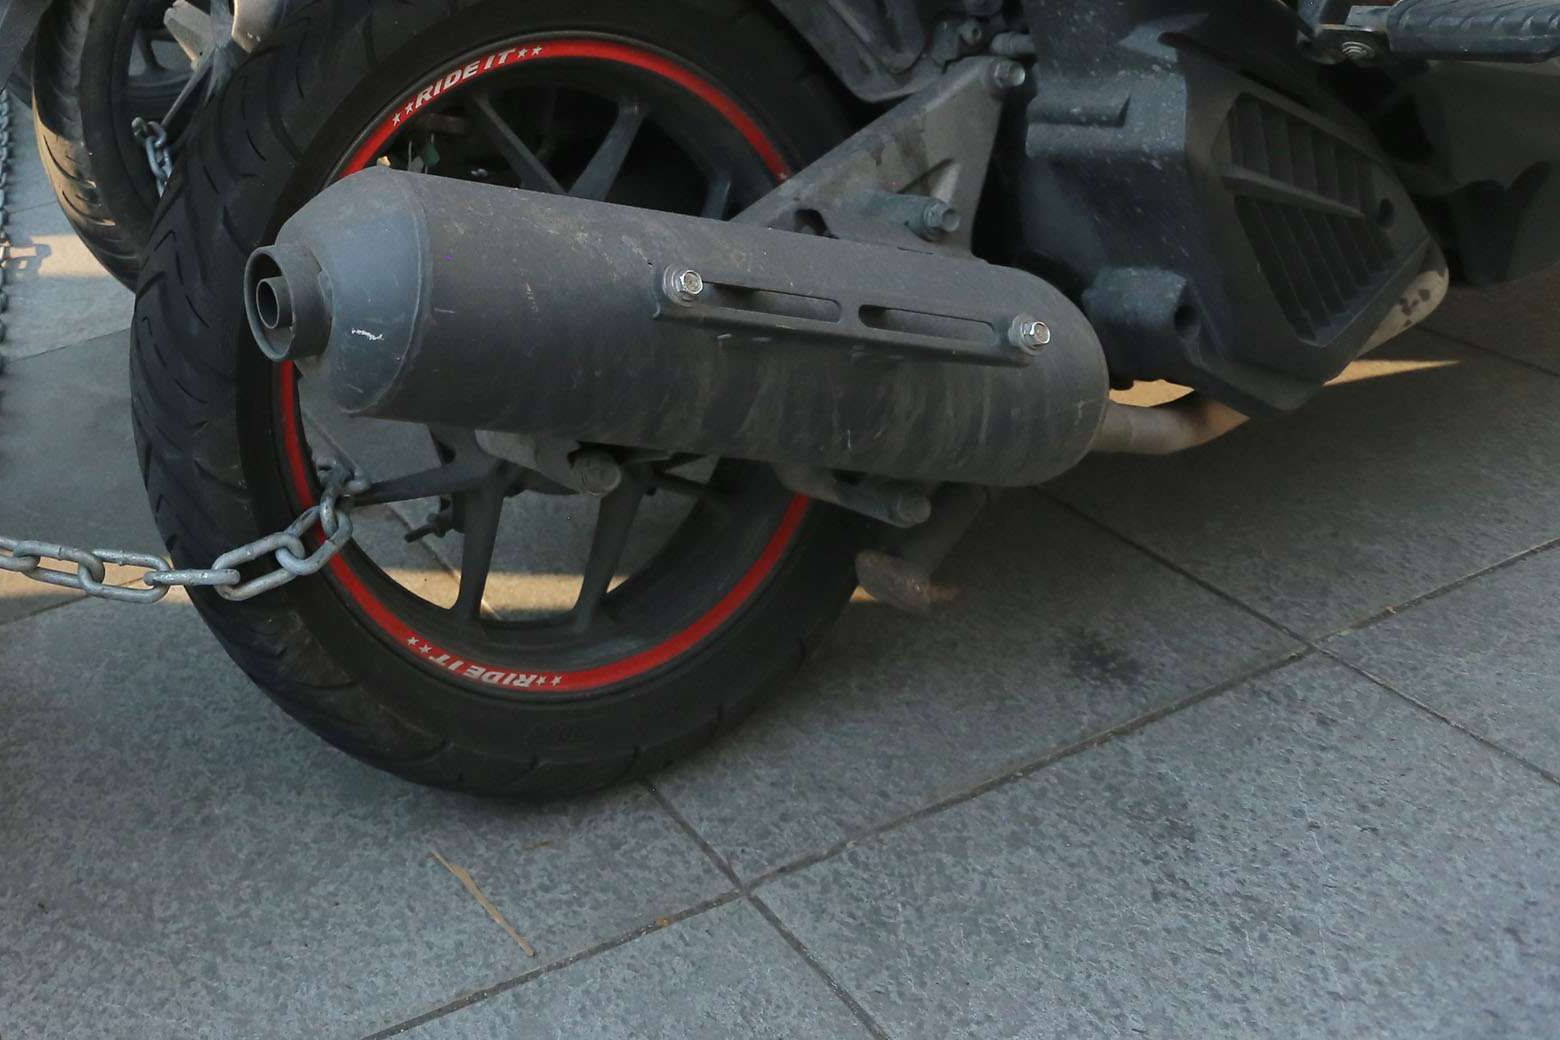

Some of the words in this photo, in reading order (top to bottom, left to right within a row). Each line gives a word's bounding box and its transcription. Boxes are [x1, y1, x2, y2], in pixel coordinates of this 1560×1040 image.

[414, 60, 481, 109] RIDE
[484, 48, 515, 70] IT
[428, 654, 464, 671] IT
[463, 665, 538, 688] RIDE
